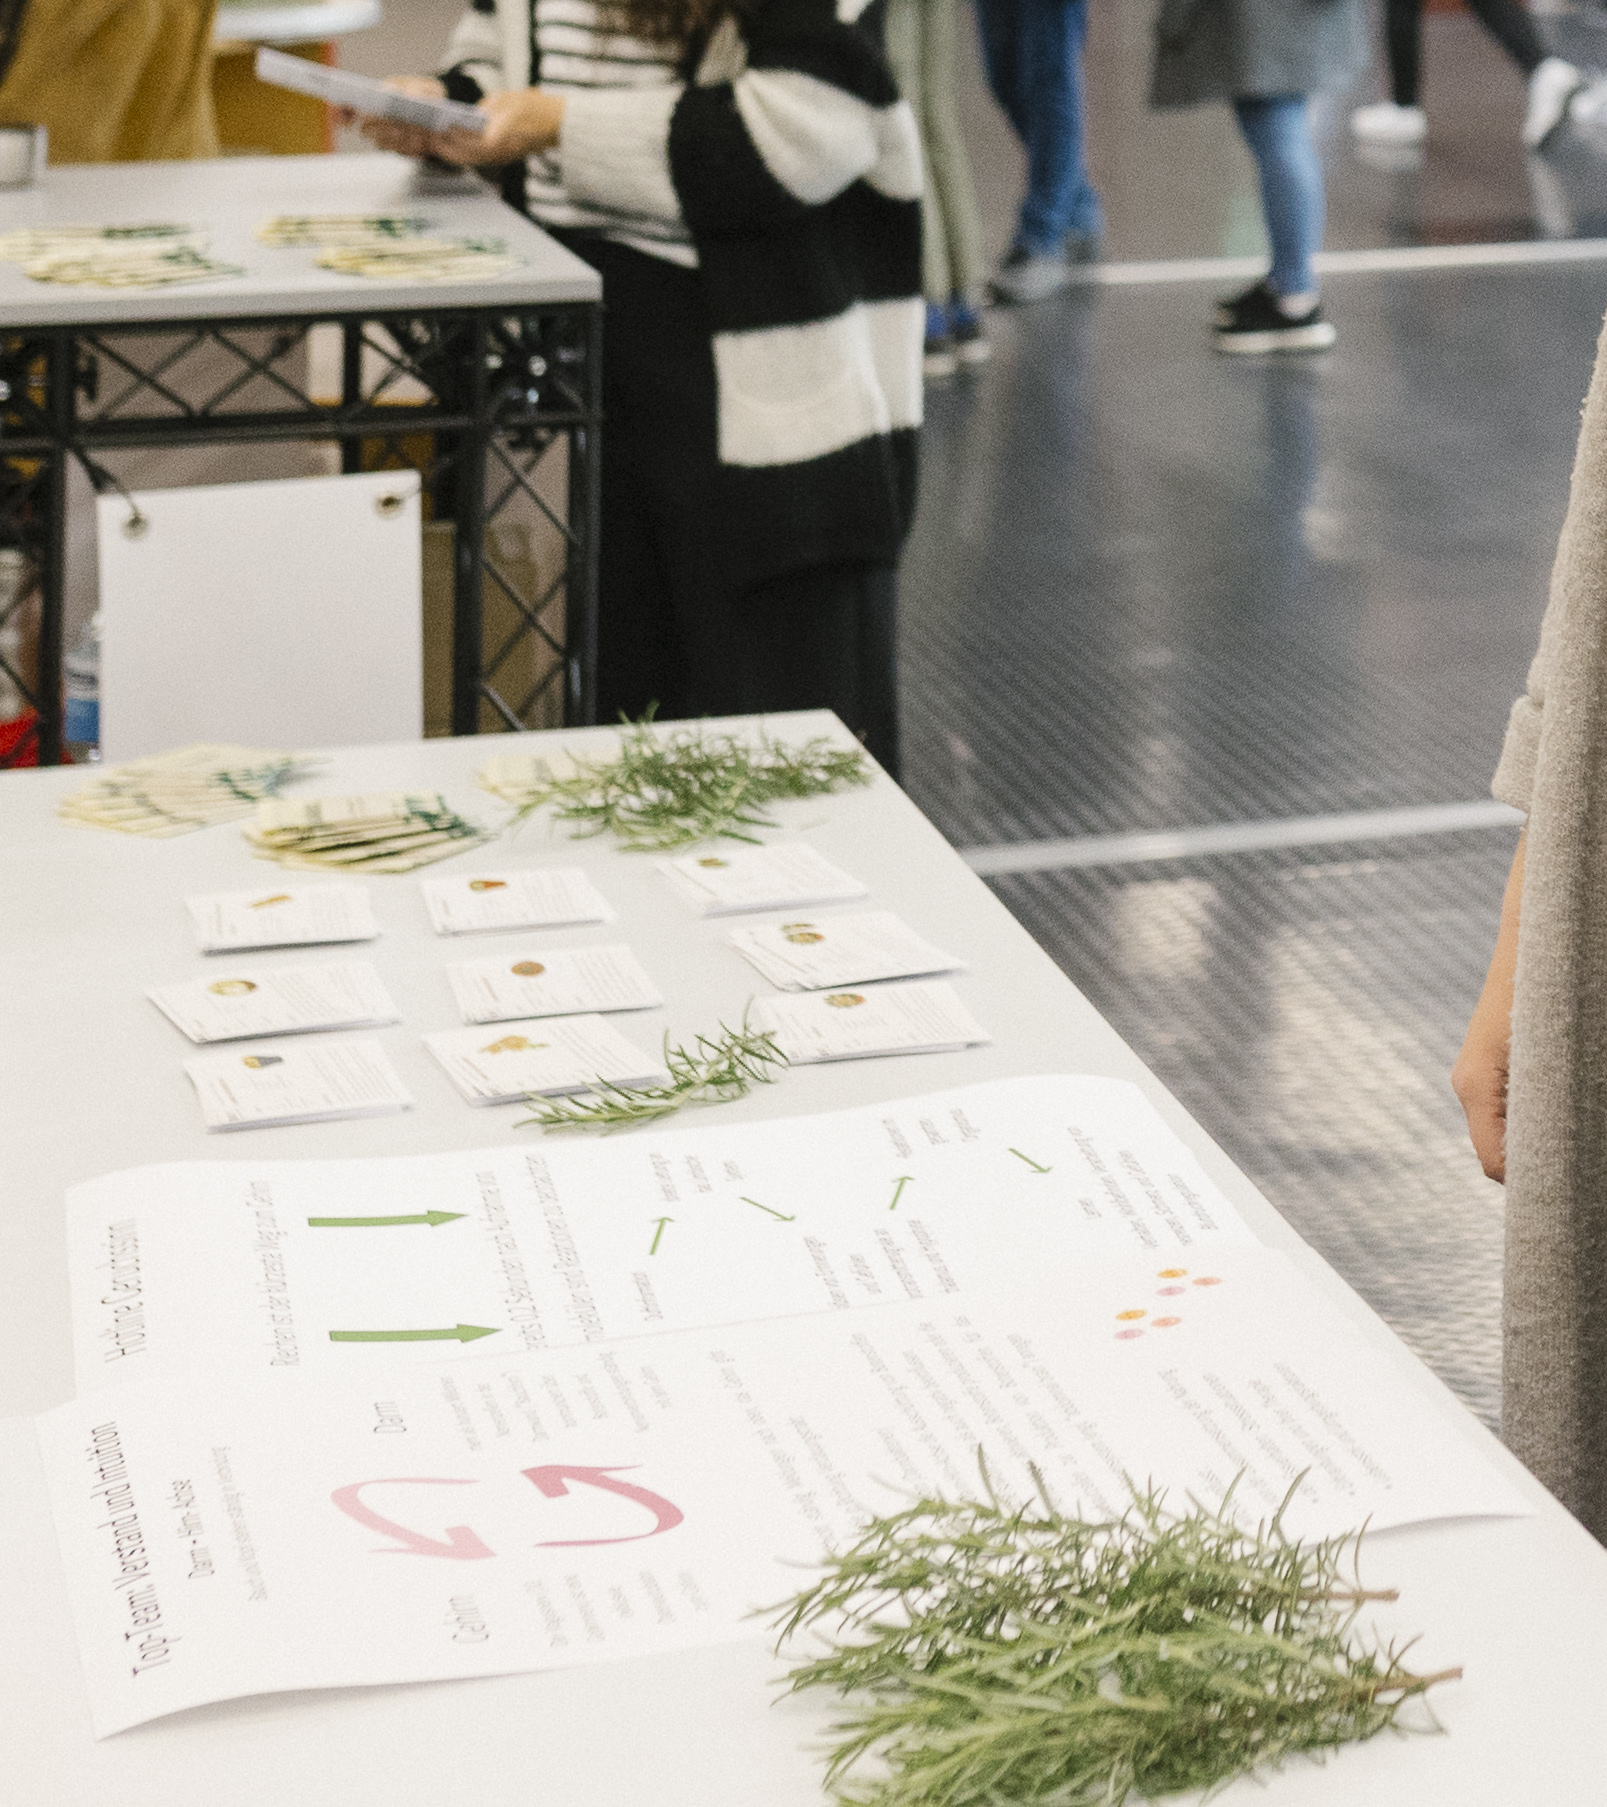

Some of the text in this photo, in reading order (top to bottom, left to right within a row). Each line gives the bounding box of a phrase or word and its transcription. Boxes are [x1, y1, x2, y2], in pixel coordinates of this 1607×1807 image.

[374, 1401, 407, 1434] Darm
[85, 1421, 184, 1676] Top-Team: Verstand und Intuition
[188, 1547, 215, 1580] Darm
